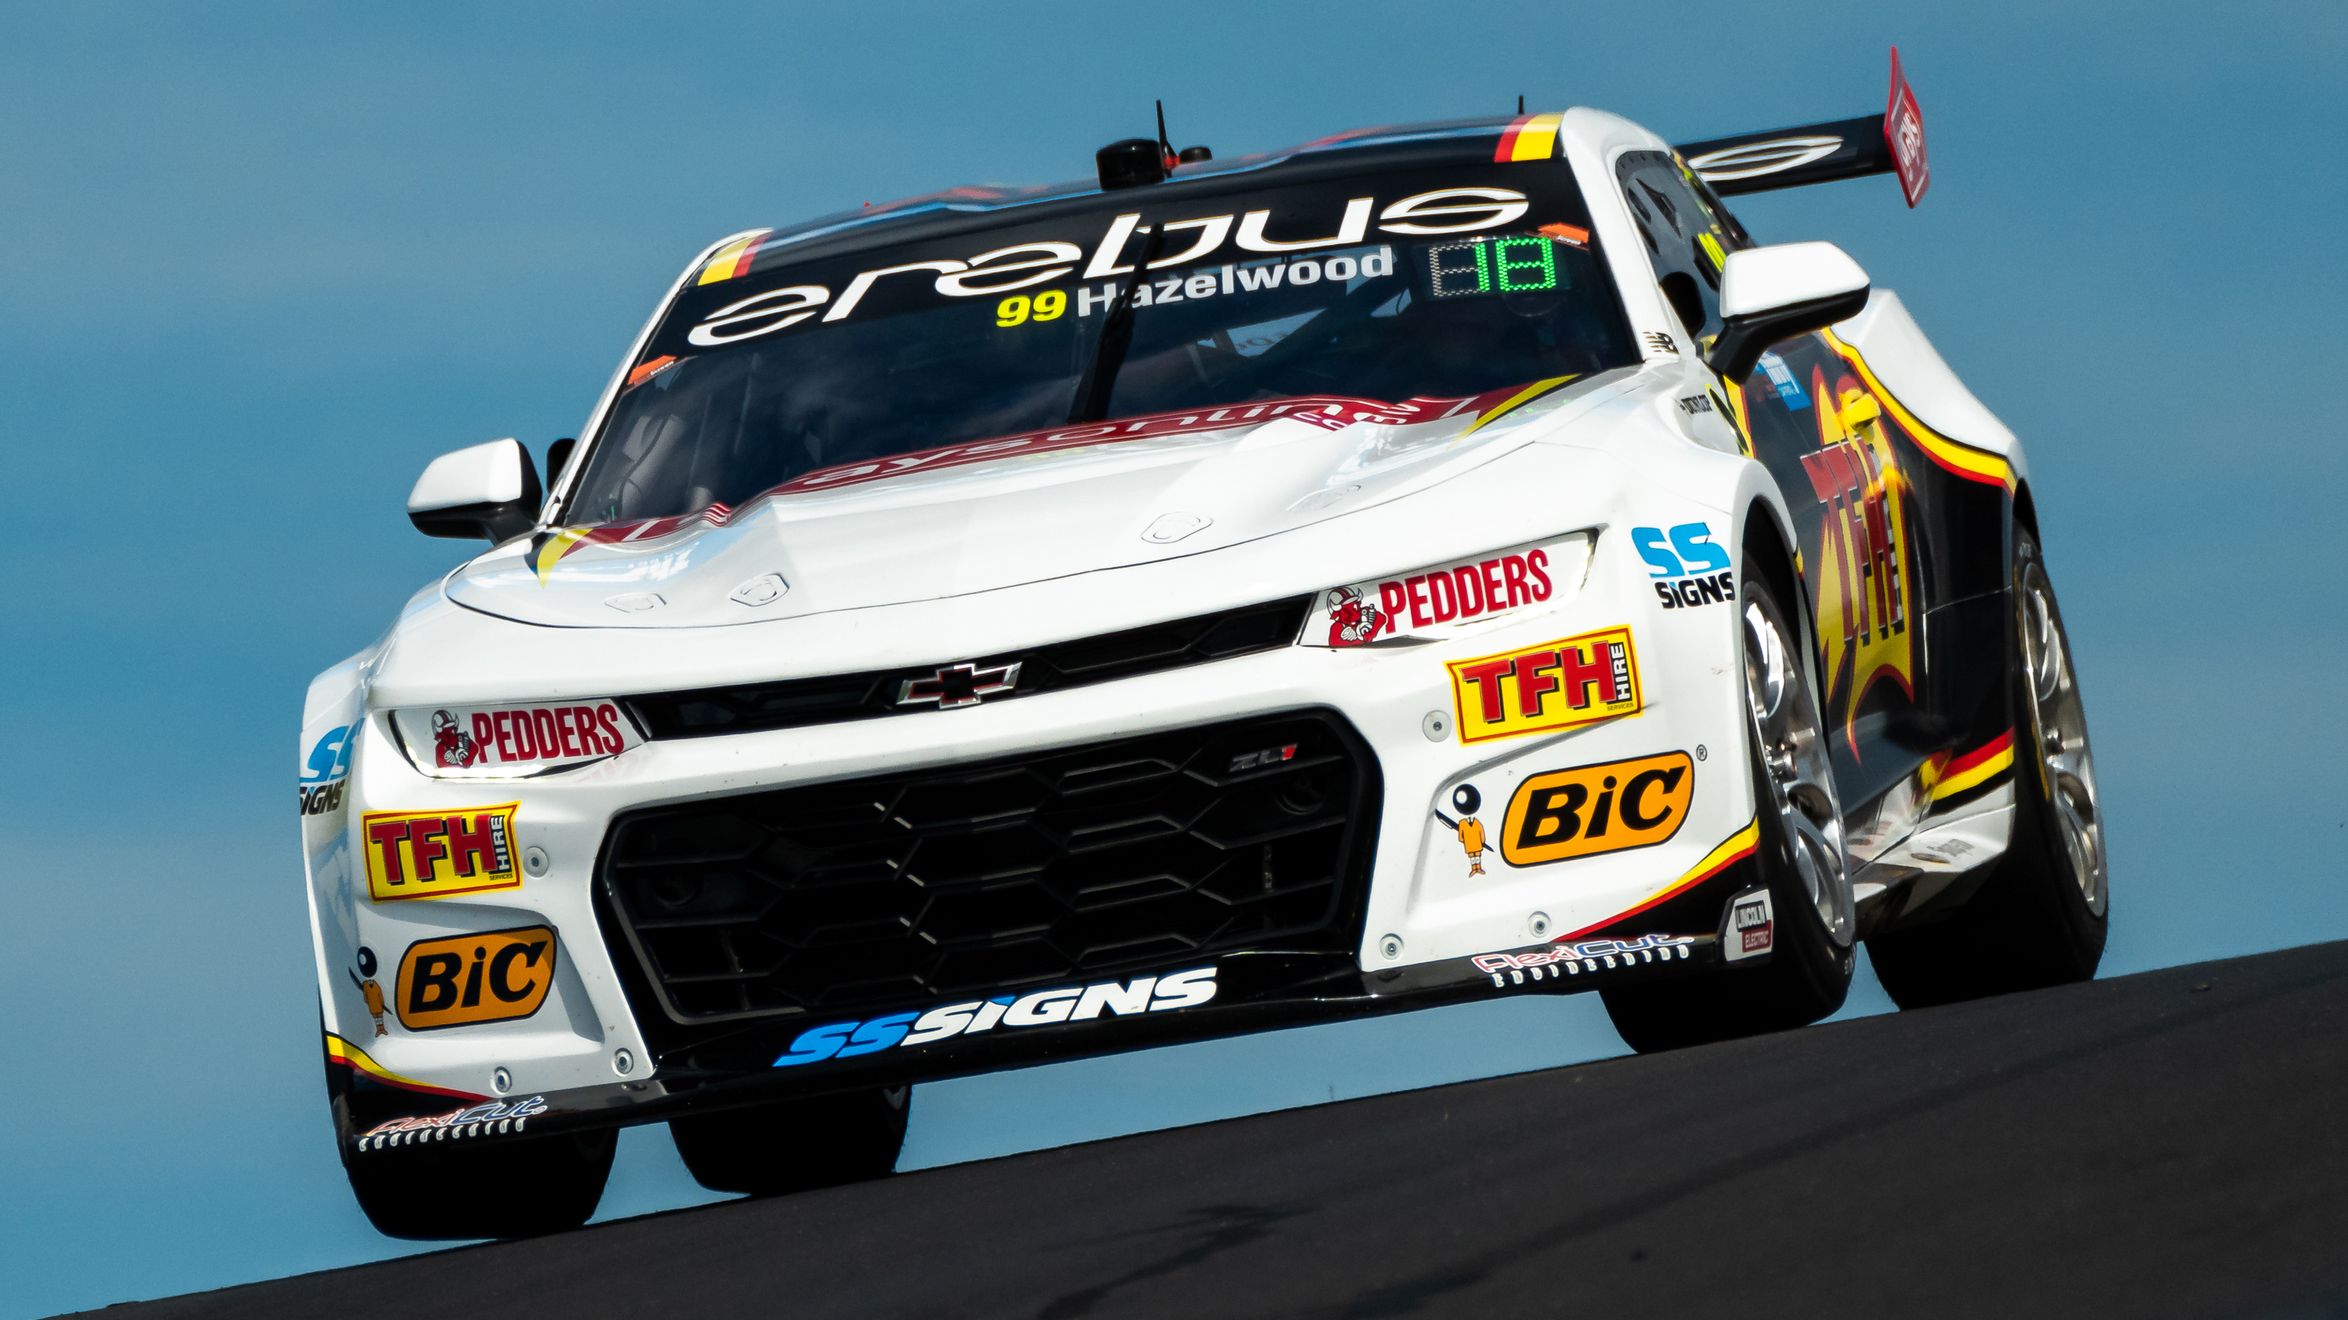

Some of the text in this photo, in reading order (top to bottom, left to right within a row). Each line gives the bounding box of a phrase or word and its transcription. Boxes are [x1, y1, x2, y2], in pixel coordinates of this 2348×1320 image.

[687, 187, 1530, 346] erebus
[995, 244, 1394, 328] 99 Hazelwood
[1631, 522, 1732, 579] SS
[1378, 549, 1553, 634] PEDDERS
[1460, 640, 1617, 724] TFH
[1610, 643, 1631, 701] HIRE
[471, 703, 625, 764] PEDDERS
[369, 814, 500, 886] TFH
[490, 816, 511, 871] HIRE
[1736, 902, 1766, 929] LINCOLN
[1744, 929, 1769, 949] ELECTRIC
